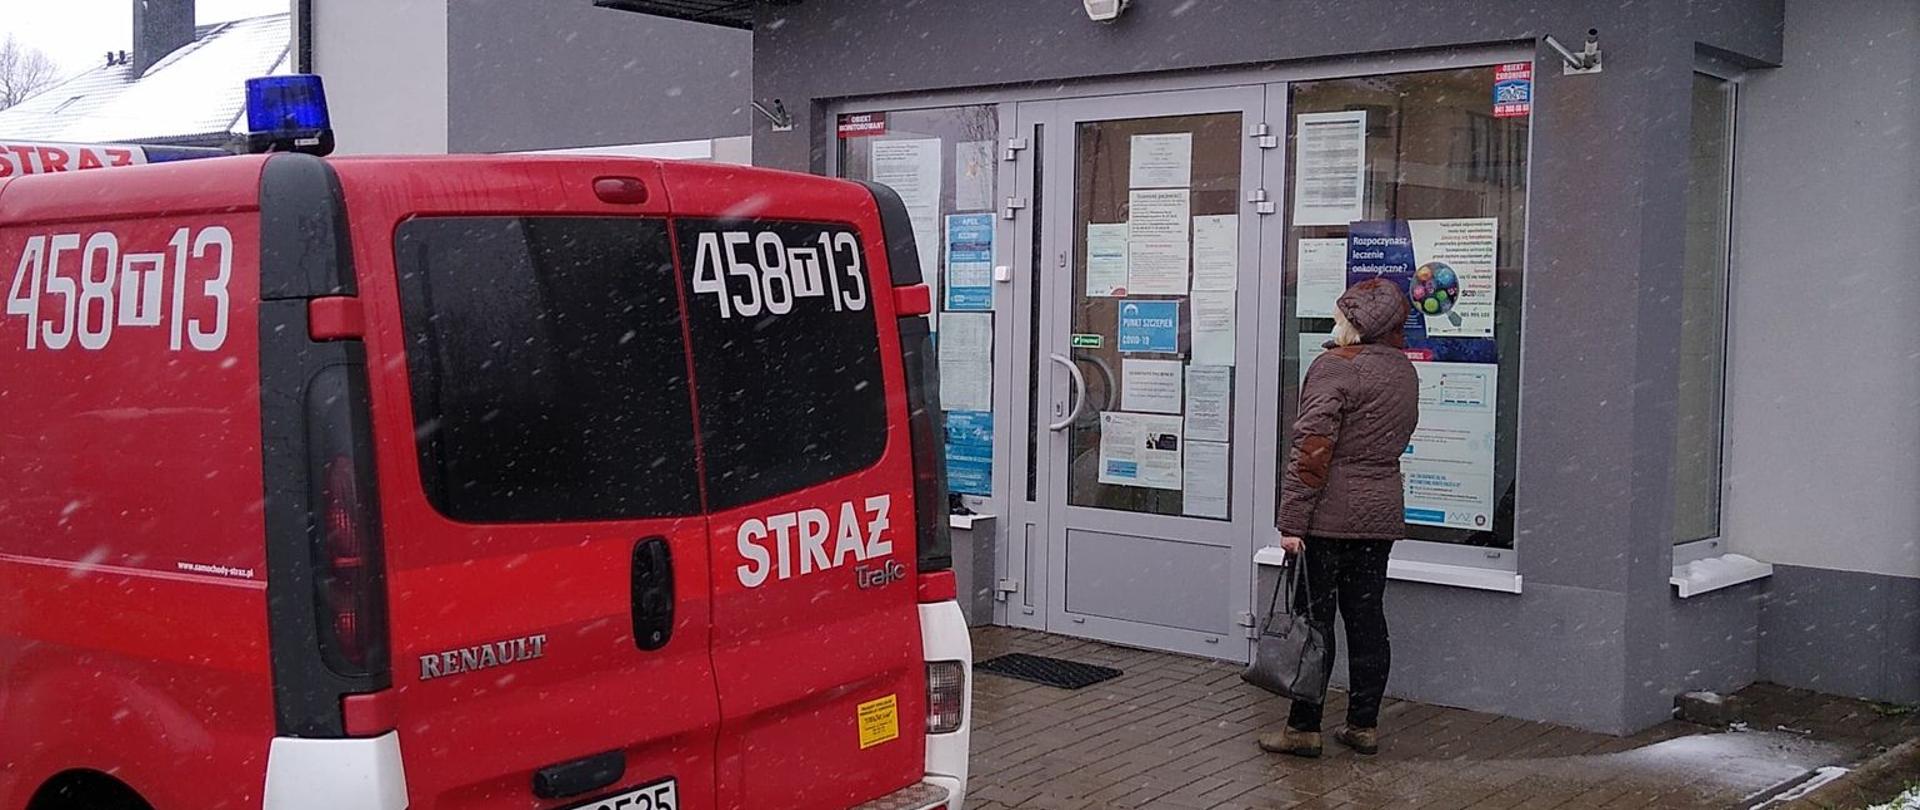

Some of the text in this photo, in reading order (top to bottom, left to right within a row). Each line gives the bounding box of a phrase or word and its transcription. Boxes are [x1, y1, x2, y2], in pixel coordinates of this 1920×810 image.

[1353, 237, 1407, 247] Rozpoczynasz
[1352, 250, 1384, 259] leczenie
[1352, 263, 1407, 275] onkologiczne?
[1122, 335, 1150, 345] COVID-19
[856, 559, 905, 588] Trafic
[419, 634, 547, 680] RENAULT
